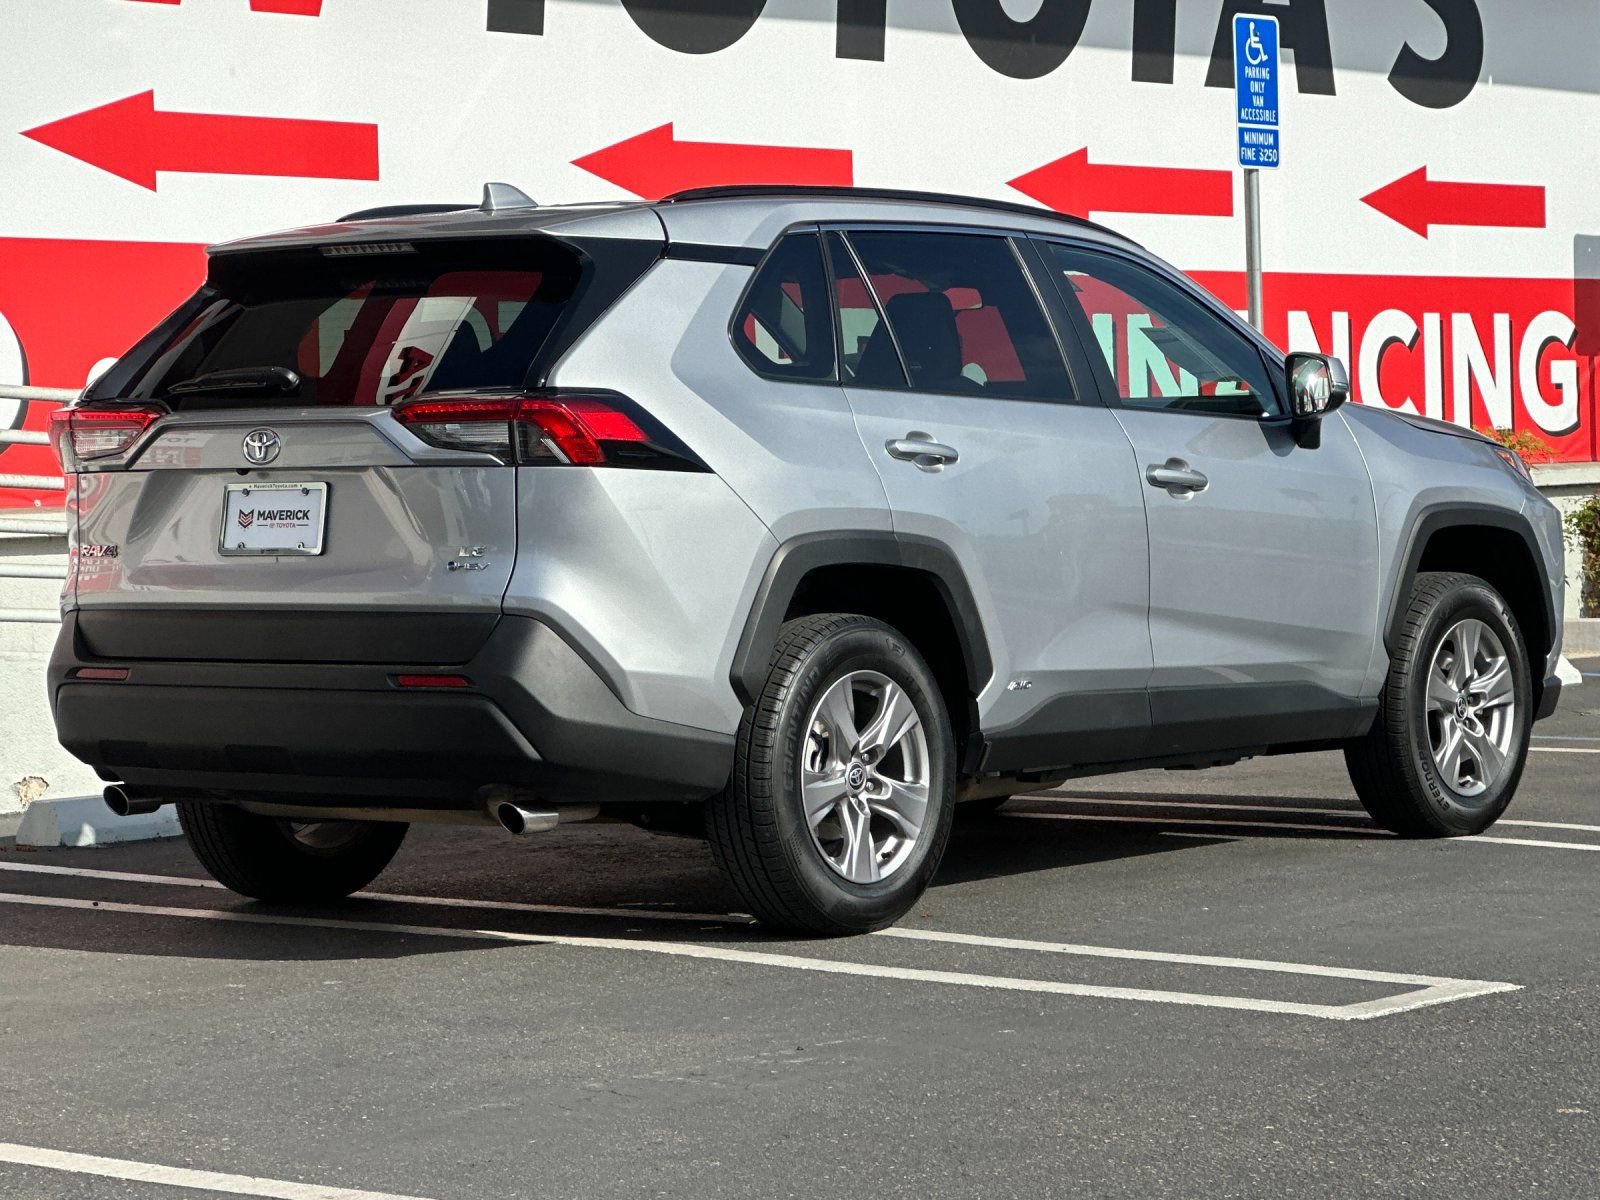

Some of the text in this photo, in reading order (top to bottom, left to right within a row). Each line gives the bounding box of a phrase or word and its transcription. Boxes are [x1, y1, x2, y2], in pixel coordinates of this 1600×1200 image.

[1244, 65, 1270, 80] PARKING
[1250, 80, 1265, 94] ONLY
[1252, 95, 1264, 107] VAN
[1240, 107, 1277, 122] ACCESSIBLE
[1243, 131, 1274, 146] MINIMUM
[1240, 146, 1278, 162] FINE $250
[257, 509, 310, 521] MAVERICK
[81, 544, 118, 558] RAV4
